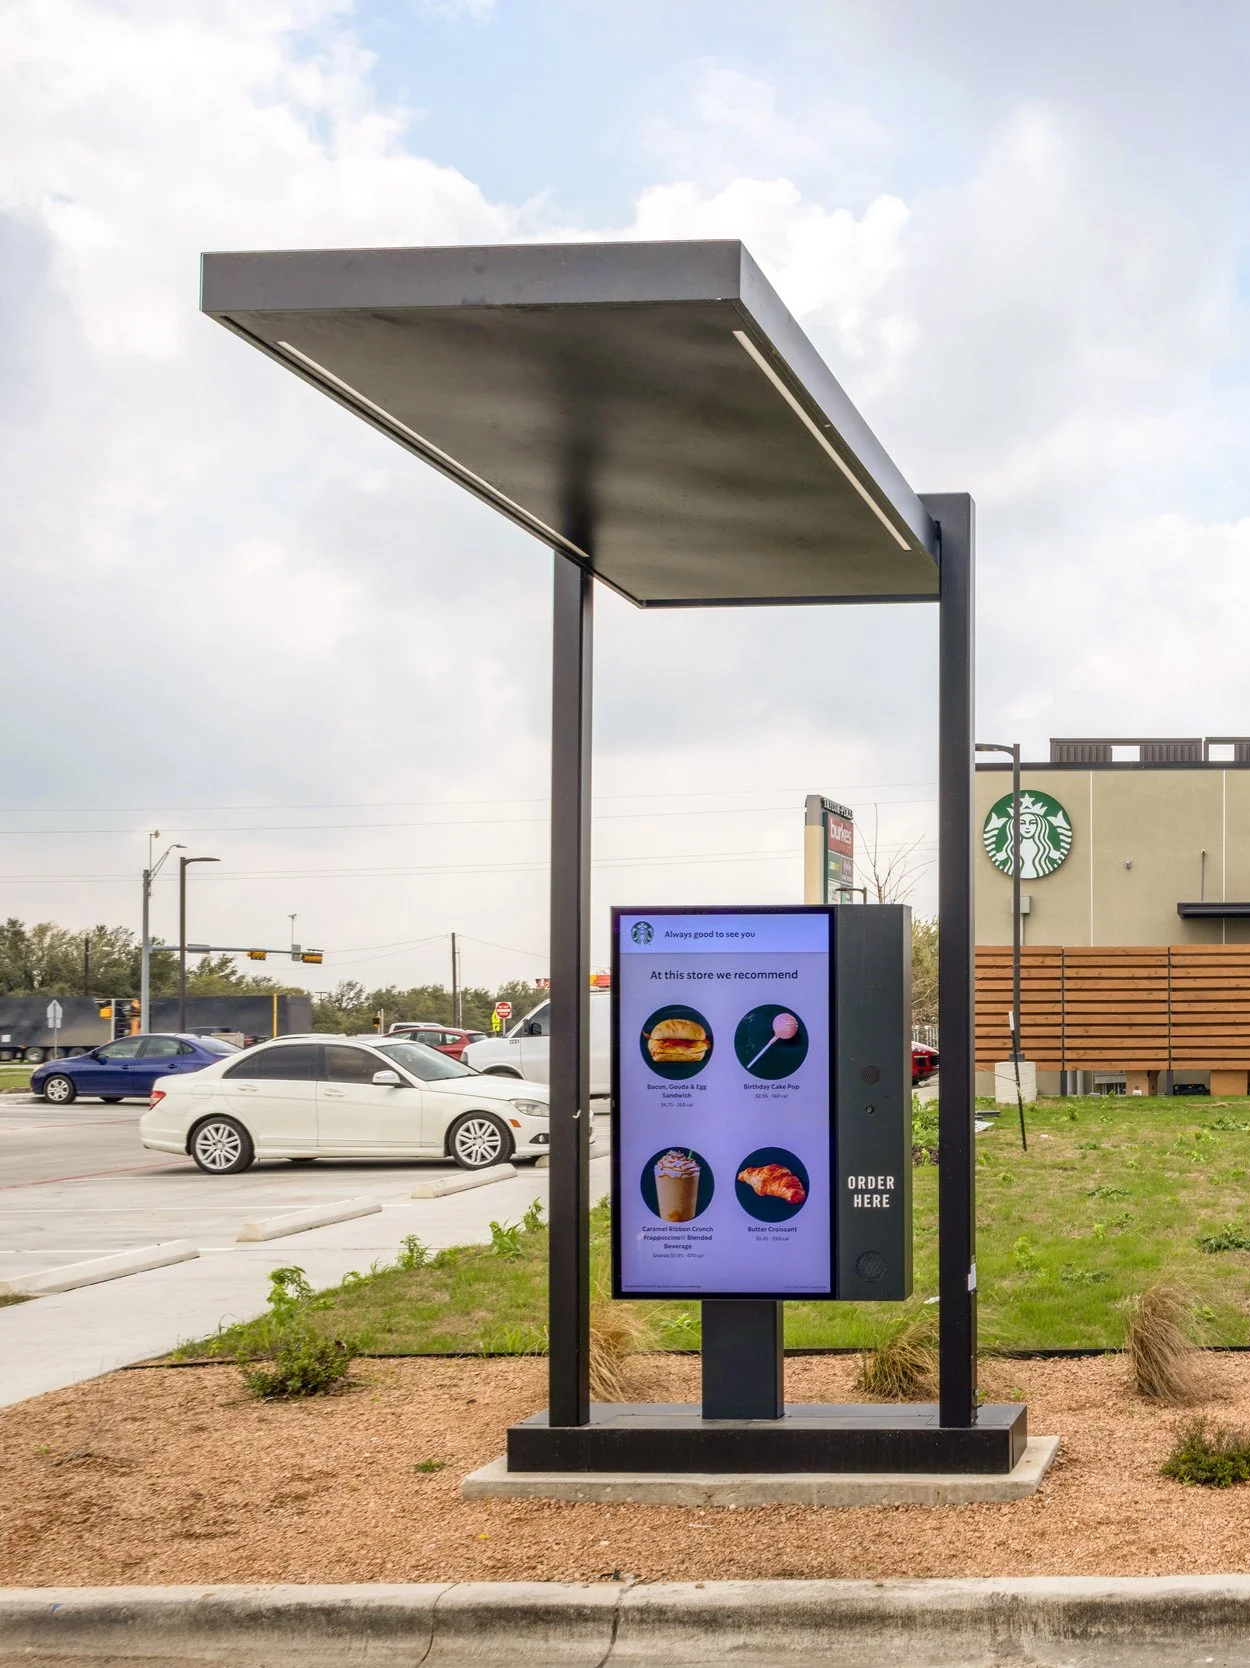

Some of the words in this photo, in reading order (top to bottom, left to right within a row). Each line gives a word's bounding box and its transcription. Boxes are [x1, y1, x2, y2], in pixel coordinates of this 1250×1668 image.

[664, 930, 691, 940] Always
[693, 930, 714, 940] good
[740, 932, 756, 940] you
[650, 970, 662, 980] At
[664, 970, 684, 980] this
[686, 971, 714, 980] store
[734, 970, 798, 980] recommend
[848, 1176, 895, 1189] ORDER
[854, 1194, 890, 1208] HERE
